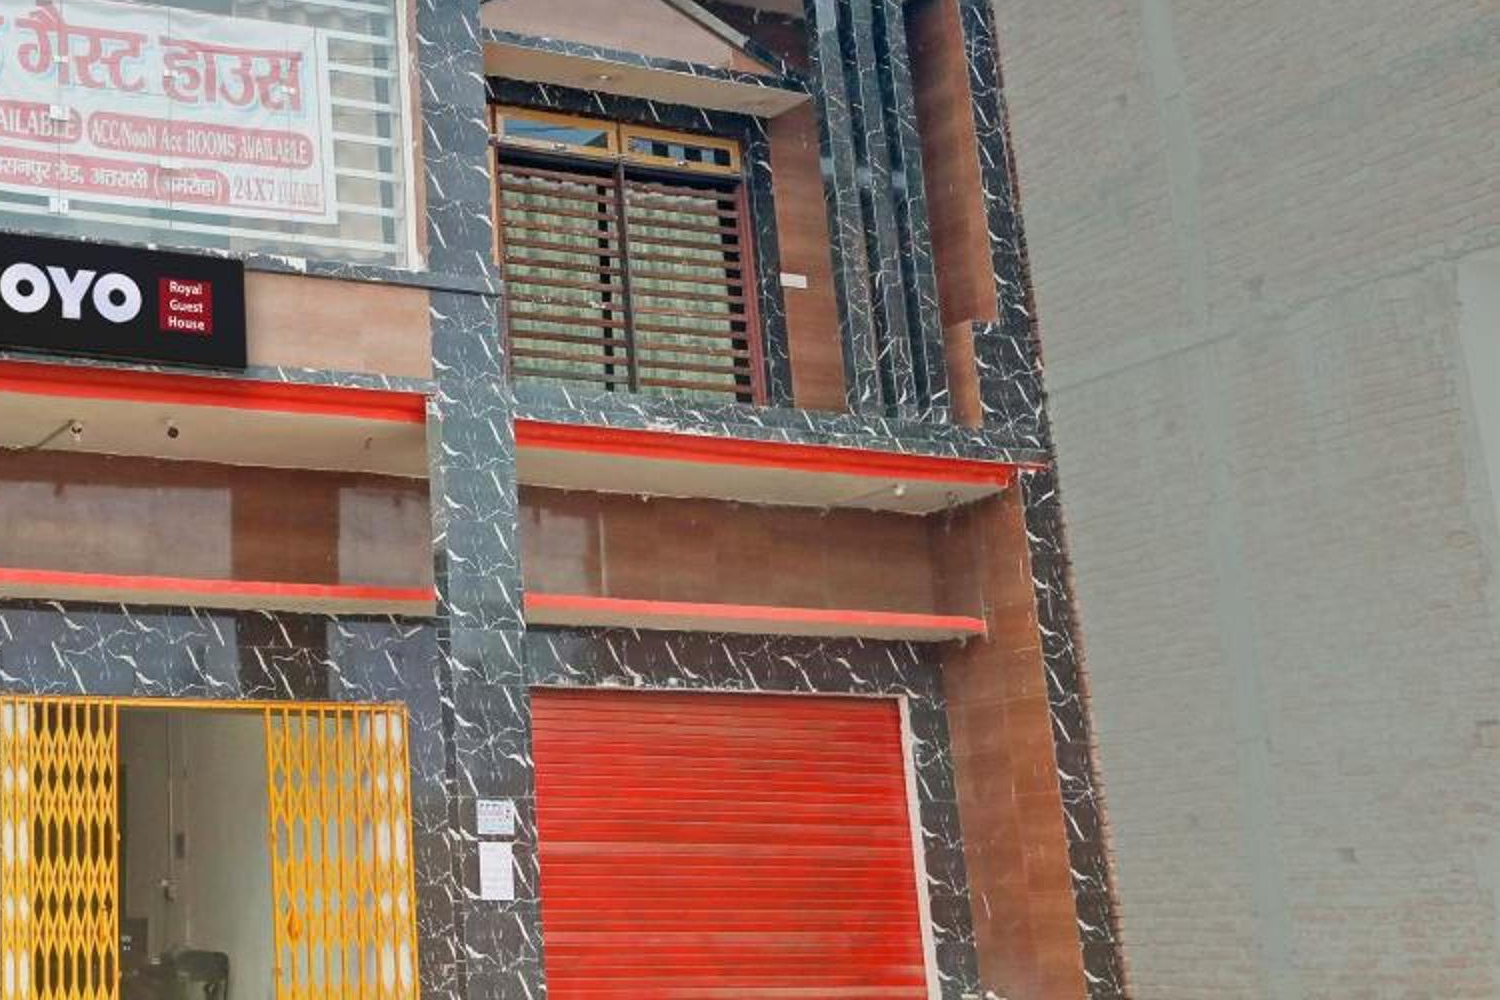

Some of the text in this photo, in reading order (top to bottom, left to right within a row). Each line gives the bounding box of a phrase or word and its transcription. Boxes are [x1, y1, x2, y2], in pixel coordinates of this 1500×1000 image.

[158, 35, 303, 112] हाउस
[187, 128, 237, 159] ROOMS
[240, 134, 309, 165] AVAILABLE
[0, 262, 142, 323] OYO
[169, 281, 203, 295] Royal
[169, 299, 204, 314] Guest
[168, 315, 205, 330] House
